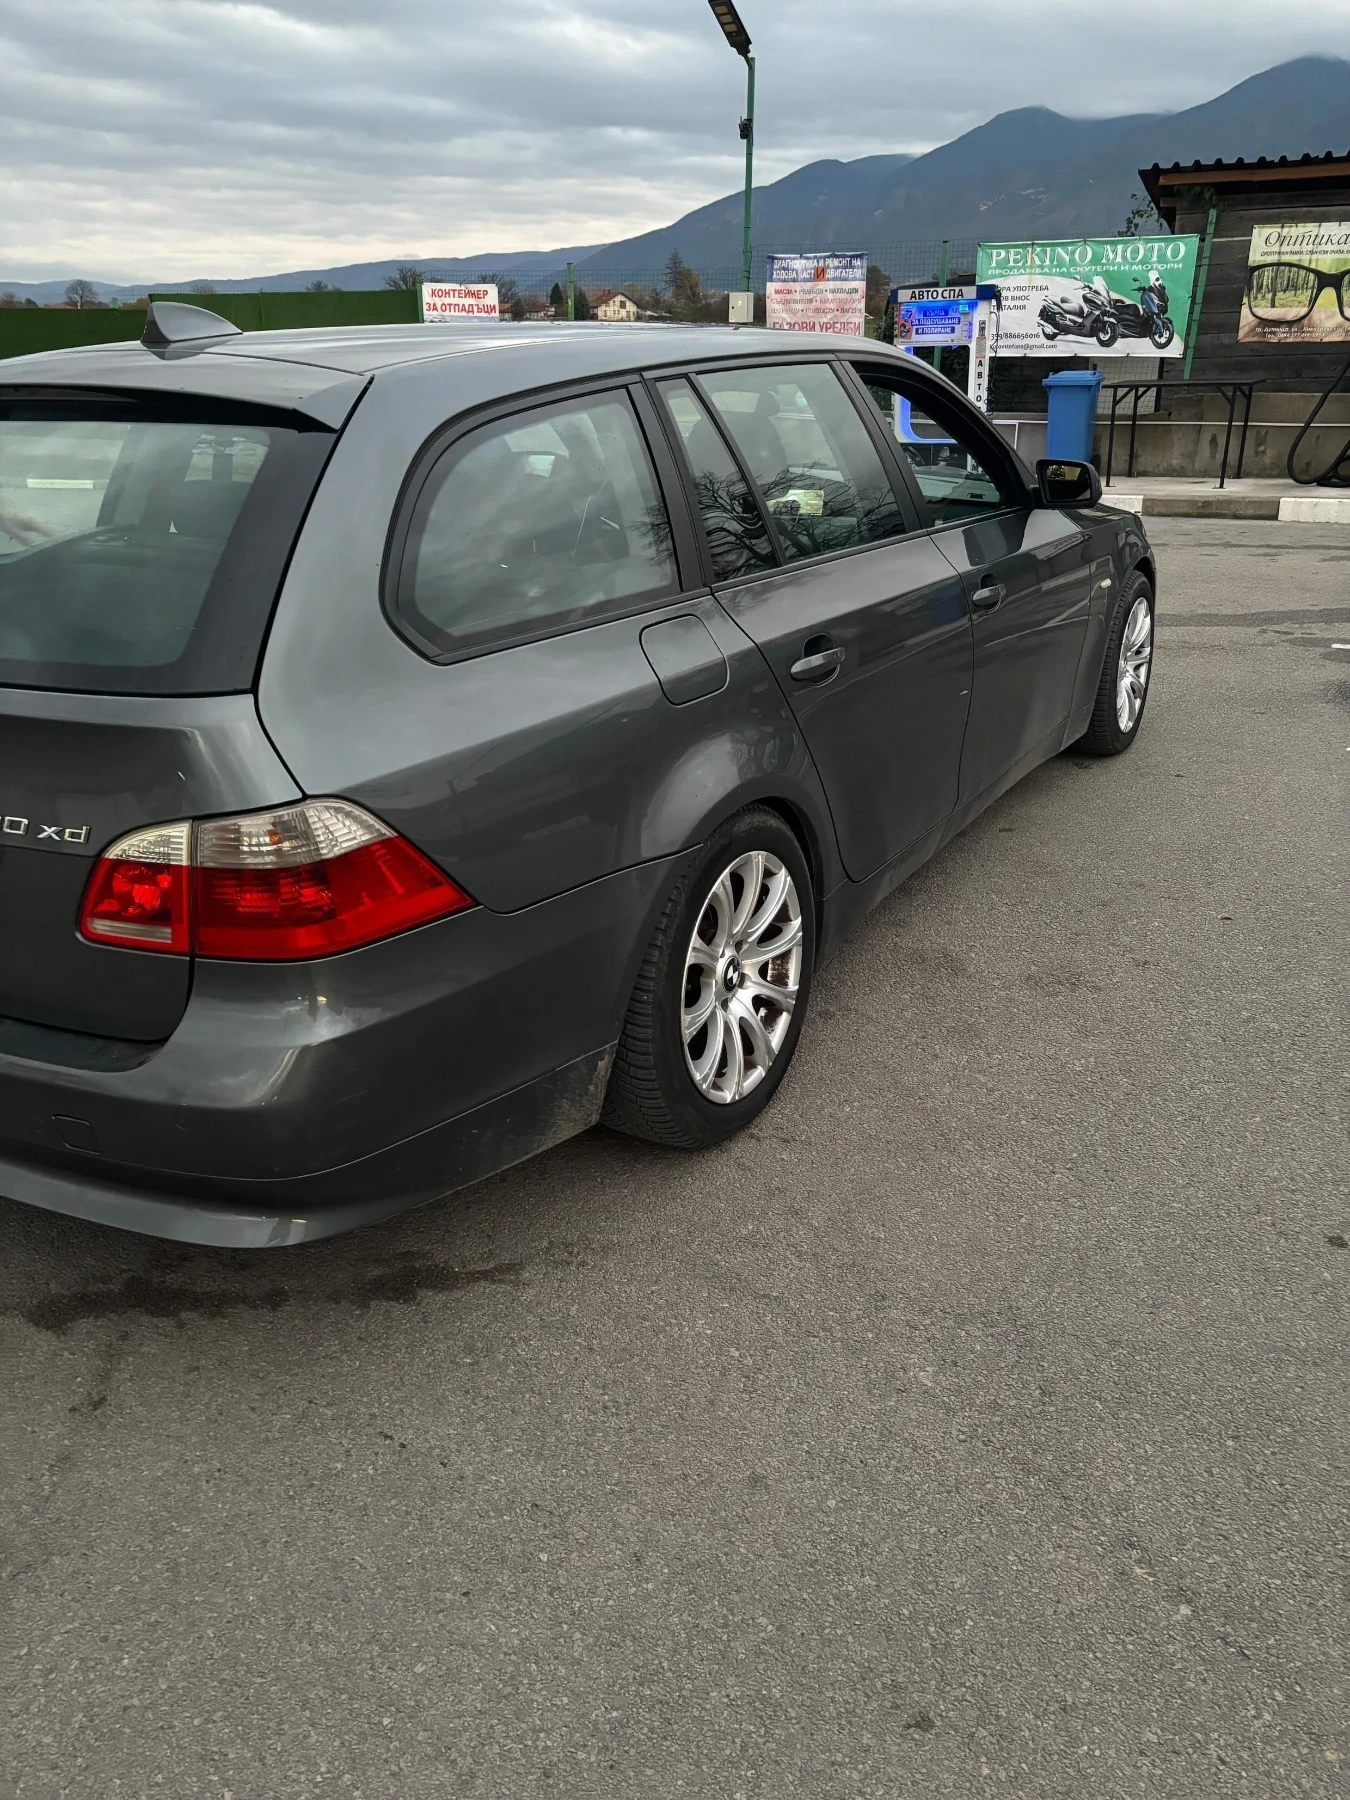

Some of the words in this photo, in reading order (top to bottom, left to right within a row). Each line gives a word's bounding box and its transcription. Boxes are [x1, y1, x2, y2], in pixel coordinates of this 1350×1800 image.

[1265, 230, 1350, 247] Оптика
[990, 244, 1093, 267] PEKINO
[1100, 241, 1186, 263] MOTO
[826, 258, 850, 266] РЕМОНТ
[851, 257, 861, 265] НА
[772, 270, 797, 279] ХОДОВА
[798, 270, 814, 279] ЧАСТ
[816, 267, 825, 279] И
[826, 268, 862, 279] ДВИГАТЕЛИ
[988, 267, 1050, 275] ПРОДАЖБА
[1052, 265, 1068, 273] НА
[1069, 264, 1118, 273] СКУТЕРИ
[1131, 262, 1183, 271] МОТОРИ
[431, 288, 489, 299] КОНТЕЙНЕР
[909, 290, 939, 301] АВТО
[940, 289, 964, 299] СПА
[425, 302, 439, 312] ЗА
[440, 303, 497, 315] ОТПАДЪЦИ
[0, 815, 29, 835] 0
[36, 825, 91, 844] xd
